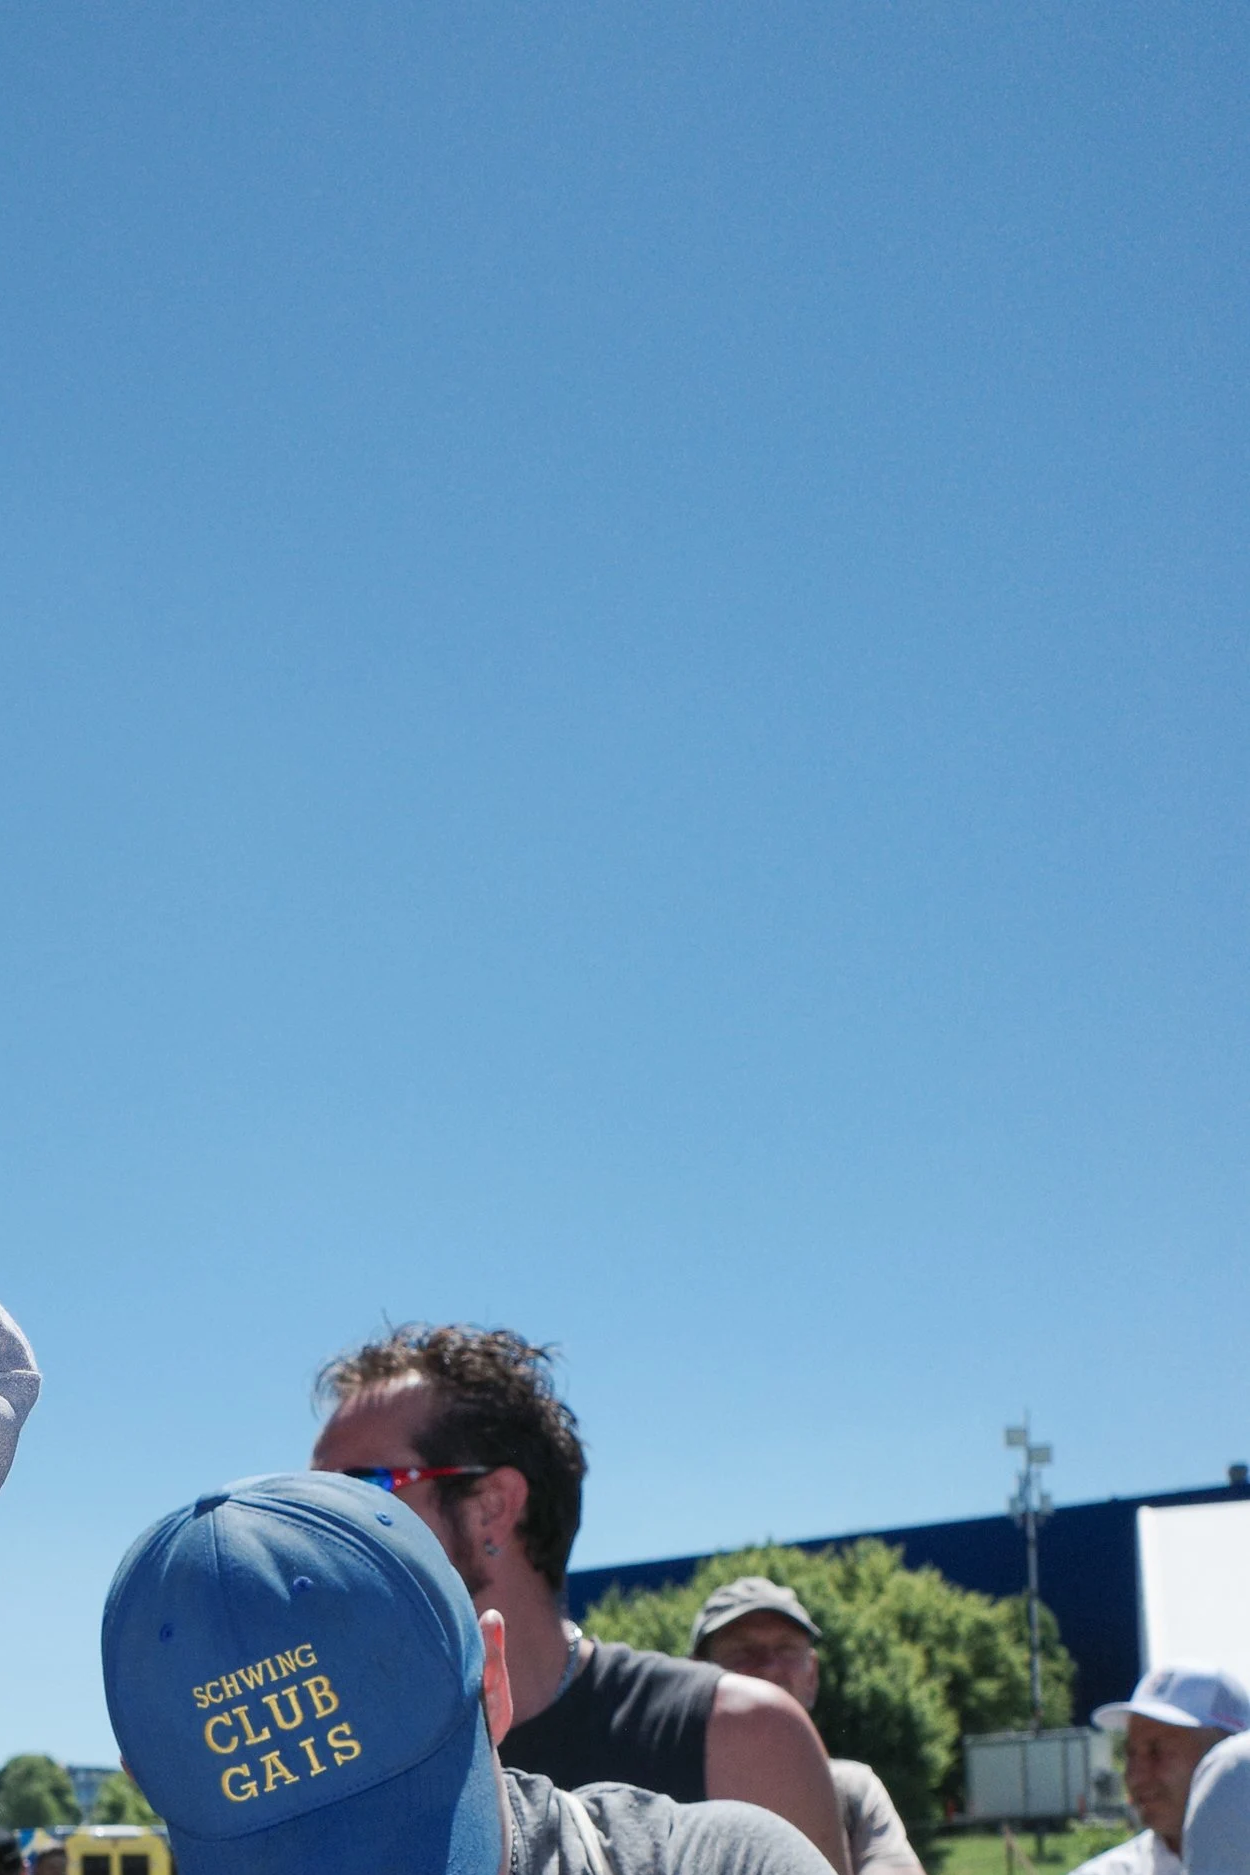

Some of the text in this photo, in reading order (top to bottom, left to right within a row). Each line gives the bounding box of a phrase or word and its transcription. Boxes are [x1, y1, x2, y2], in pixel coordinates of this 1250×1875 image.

[192, 1643, 318, 1708] SCHWING
[204, 1675, 339, 1754] CLUB
[221, 1722, 362, 1802] GAIS
